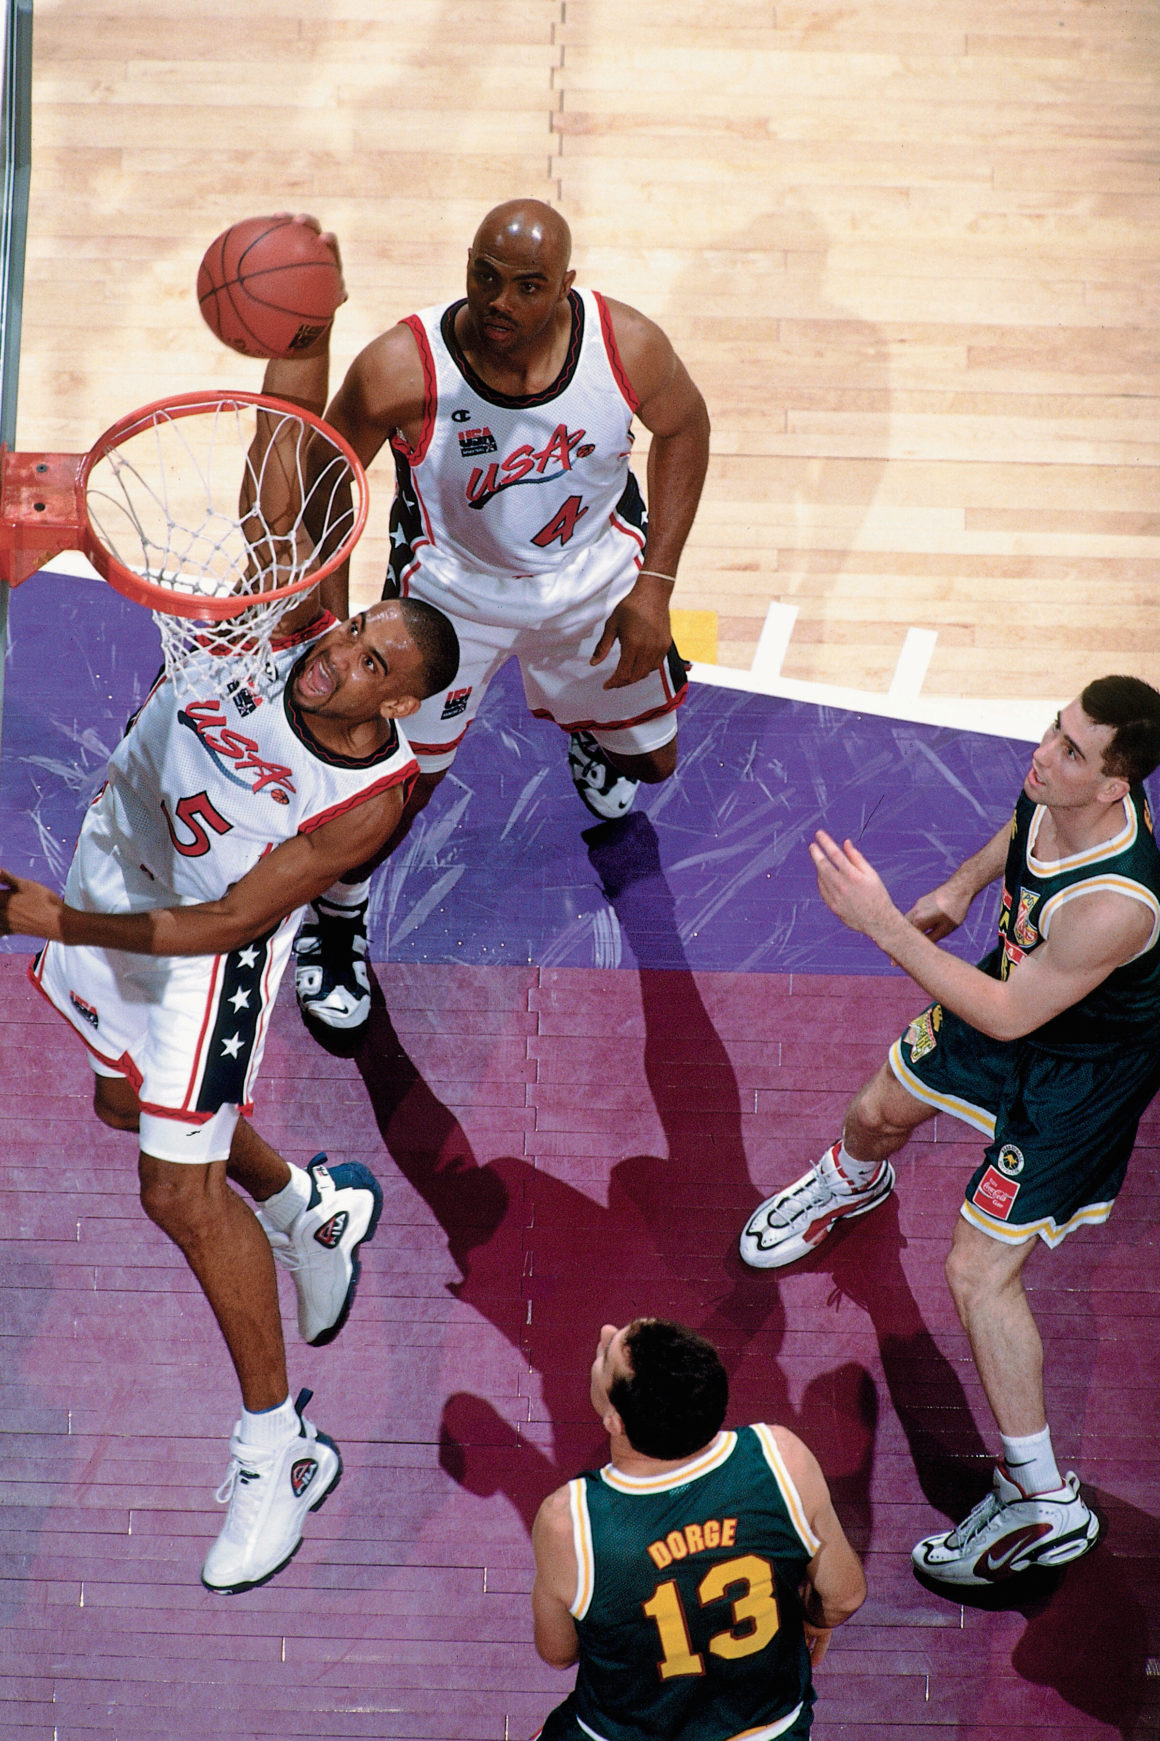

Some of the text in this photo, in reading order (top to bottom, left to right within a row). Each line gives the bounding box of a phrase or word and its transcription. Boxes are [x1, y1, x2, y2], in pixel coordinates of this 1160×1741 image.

[458, 427, 497, 450] USA
[466, 424, 586, 502] USA
[530, 495, 589, 547] 4
[185, 700, 297, 795] USA
[160, 790, 234, 858] 5
[646, 1517, 739, 1571] DORGE
[640, 1552, 781, 1683] 13
